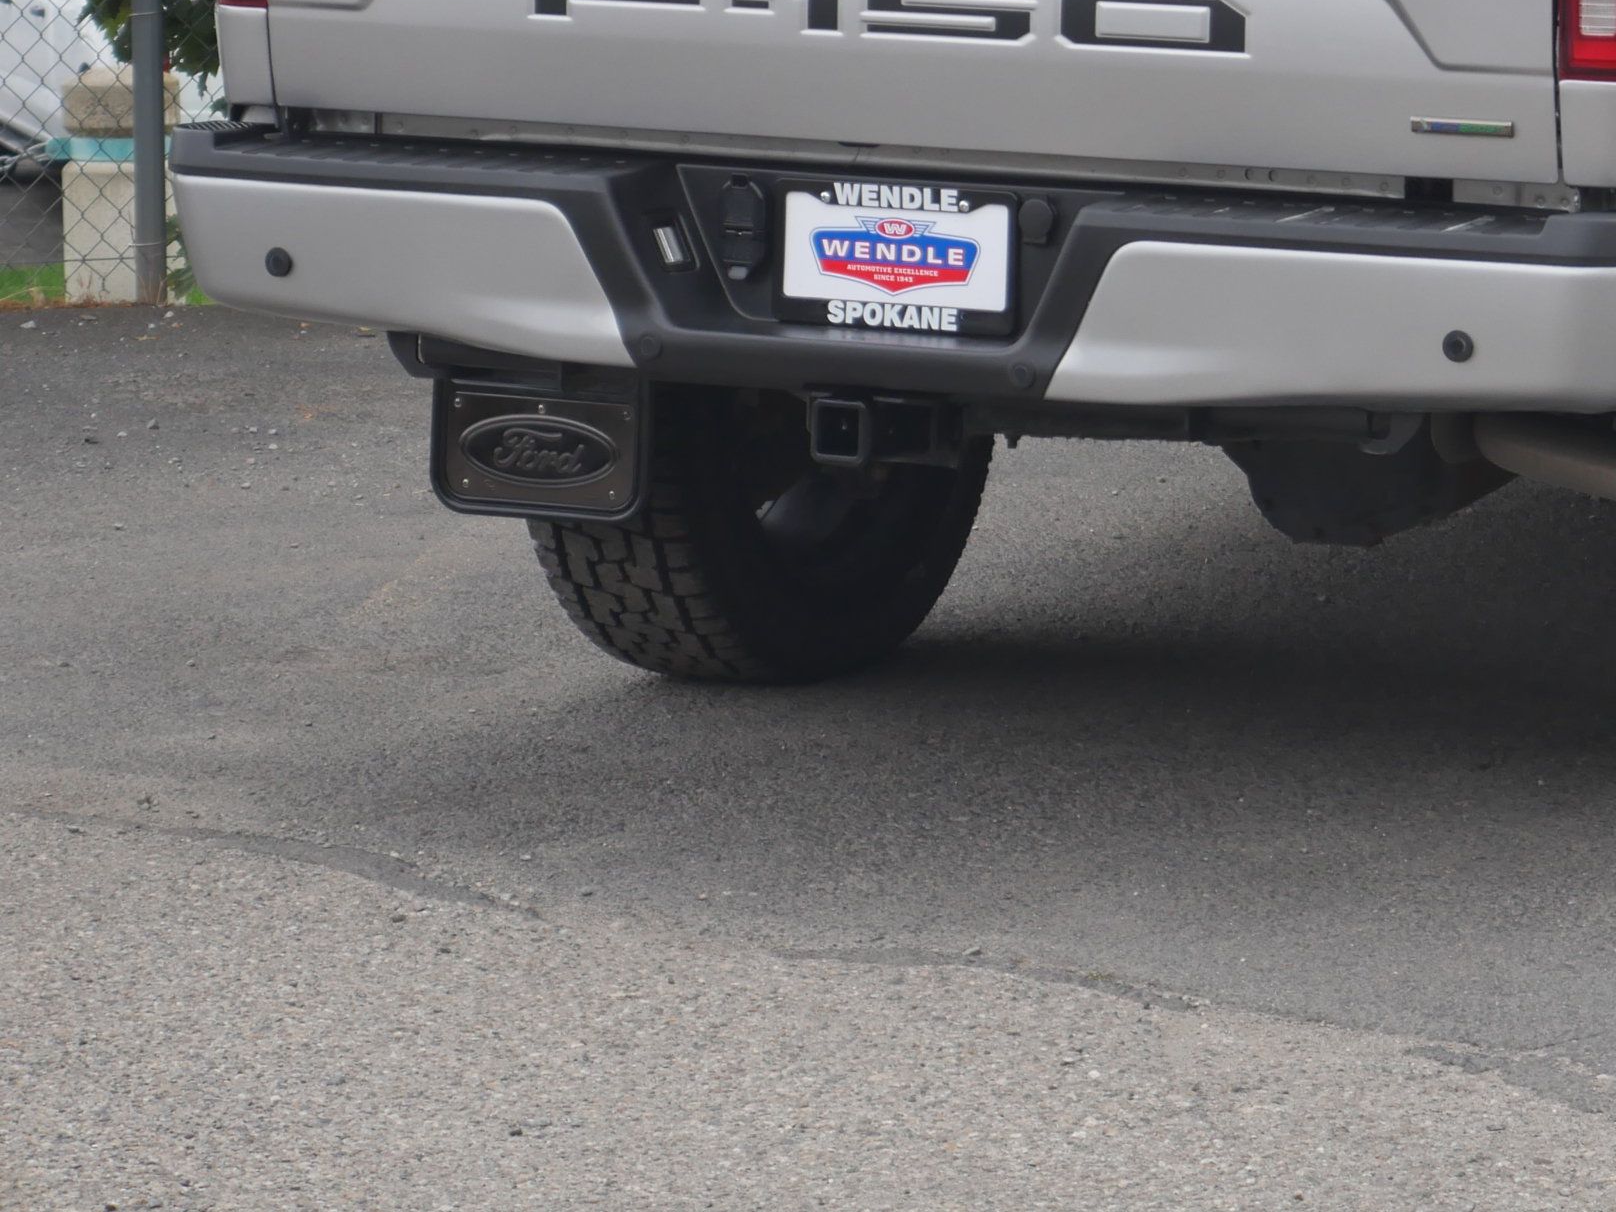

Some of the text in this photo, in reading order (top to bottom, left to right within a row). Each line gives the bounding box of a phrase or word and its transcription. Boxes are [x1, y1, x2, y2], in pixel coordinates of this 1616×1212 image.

[833, 182, 959, 212] WENDLE
[883, 222, 907, 235] W
[822, 239, 964, 266] WENDLE
[847, 264, 939, 277] AUTOMOTIVE EXCELLENCE
[873, 273, 895, 282] SINCE
[827, 300, 957, 331] SPOKANE
[494, 427, 585, 474] Ford
